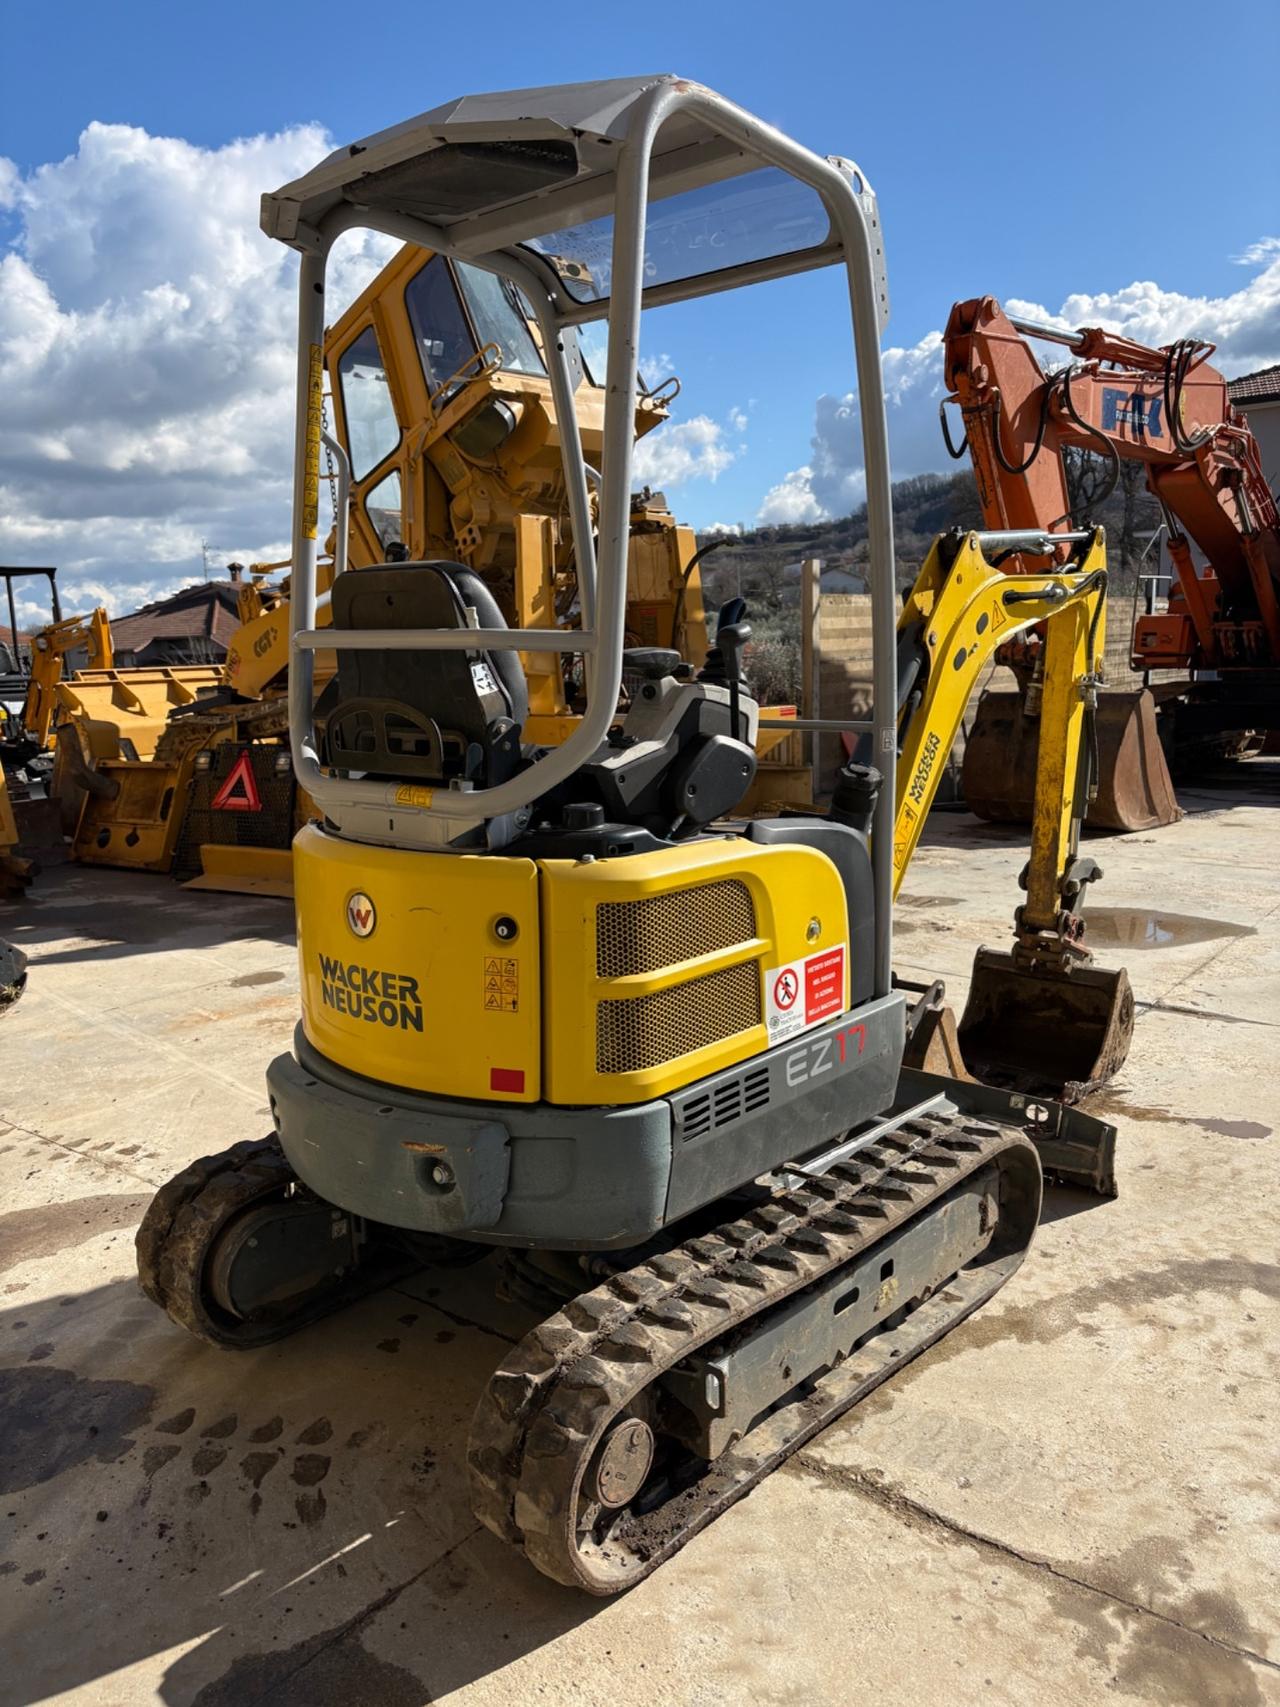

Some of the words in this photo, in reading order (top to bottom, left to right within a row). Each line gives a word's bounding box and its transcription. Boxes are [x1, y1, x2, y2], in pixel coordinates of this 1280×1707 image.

[909, 731, 937, 797] WACKER
[914, 736, 941, 805] NEUSON
[318, 953, 422, 1004] WACKER
[321, 979, 424, 1032] NEUSON
[786, 1023, 866, 1087] EZ17
